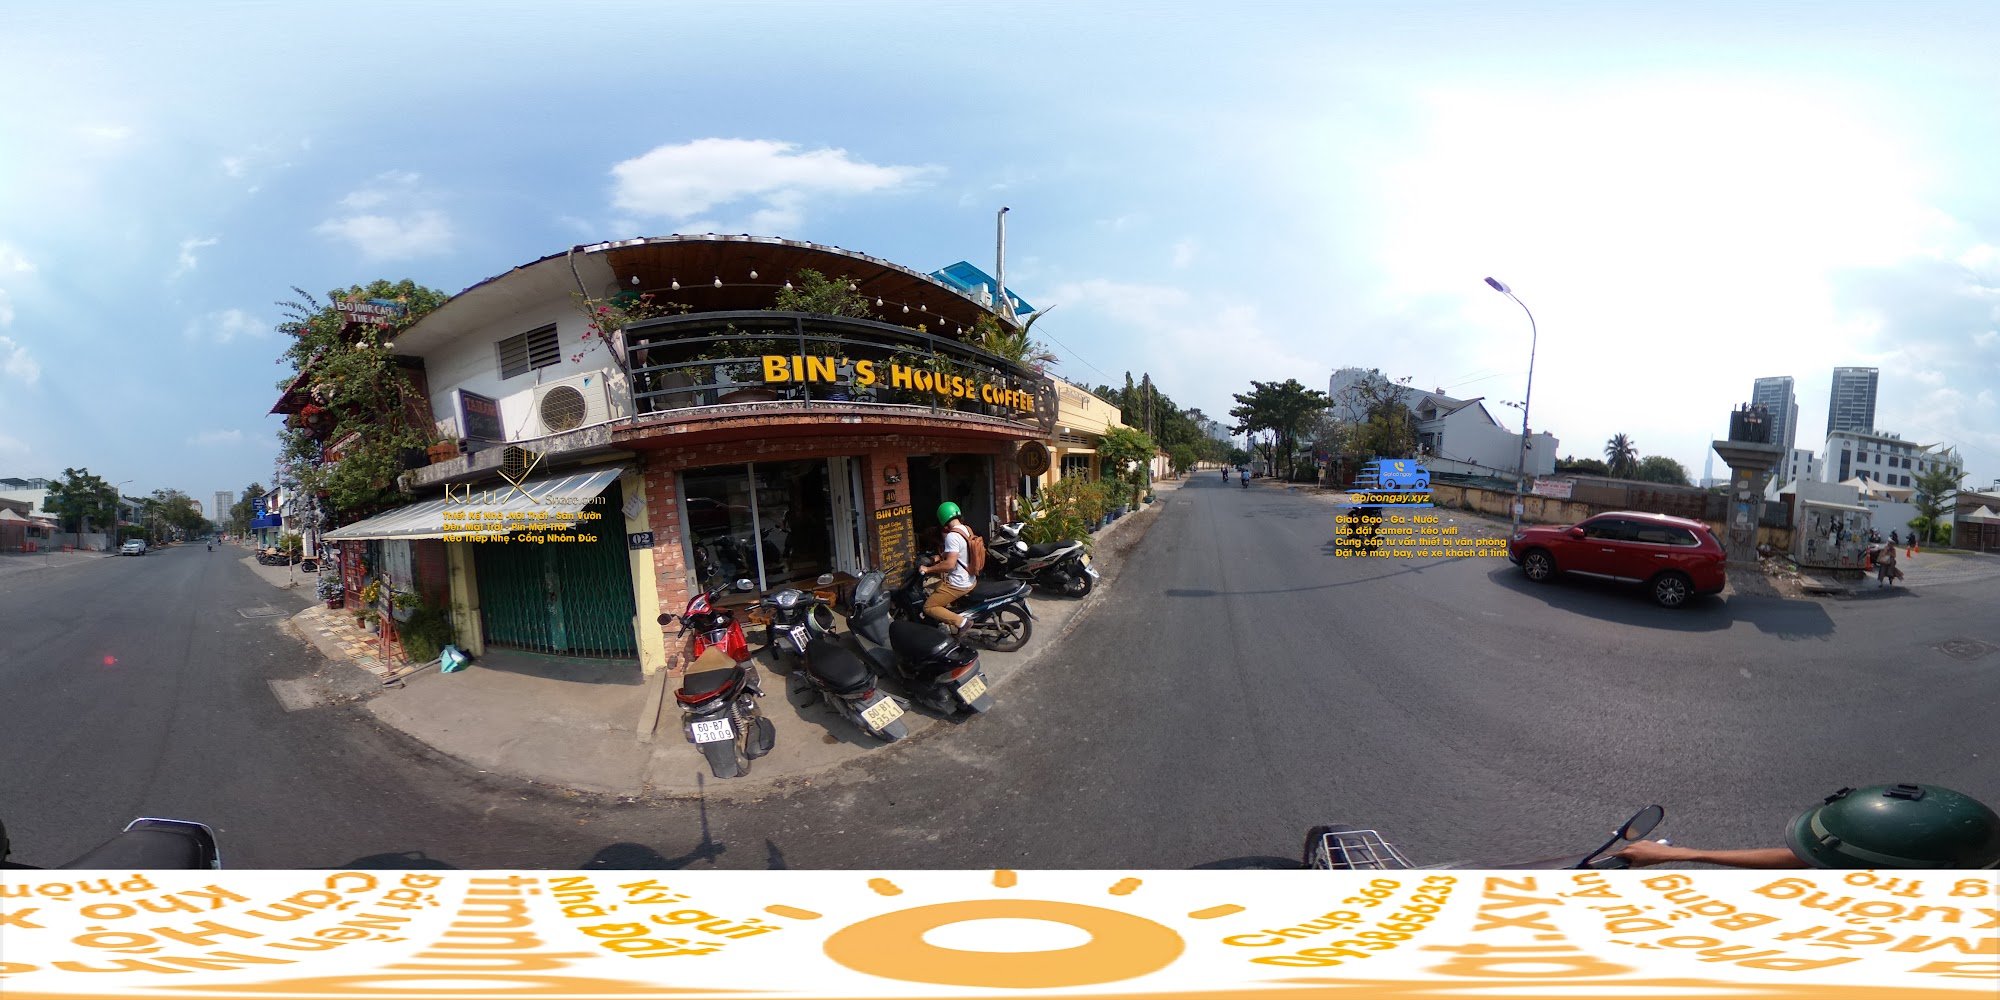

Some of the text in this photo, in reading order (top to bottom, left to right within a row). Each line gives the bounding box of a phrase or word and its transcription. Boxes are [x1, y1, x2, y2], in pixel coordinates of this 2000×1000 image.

[891, 364, 975, 399] HOUSE
[981, 383, 1035, 411] COFFEE
[876, 505, 912, 520] BIN CAFE
[632, 534, 650, 544] 02
[698, 721, 723, 732] 60-B7
